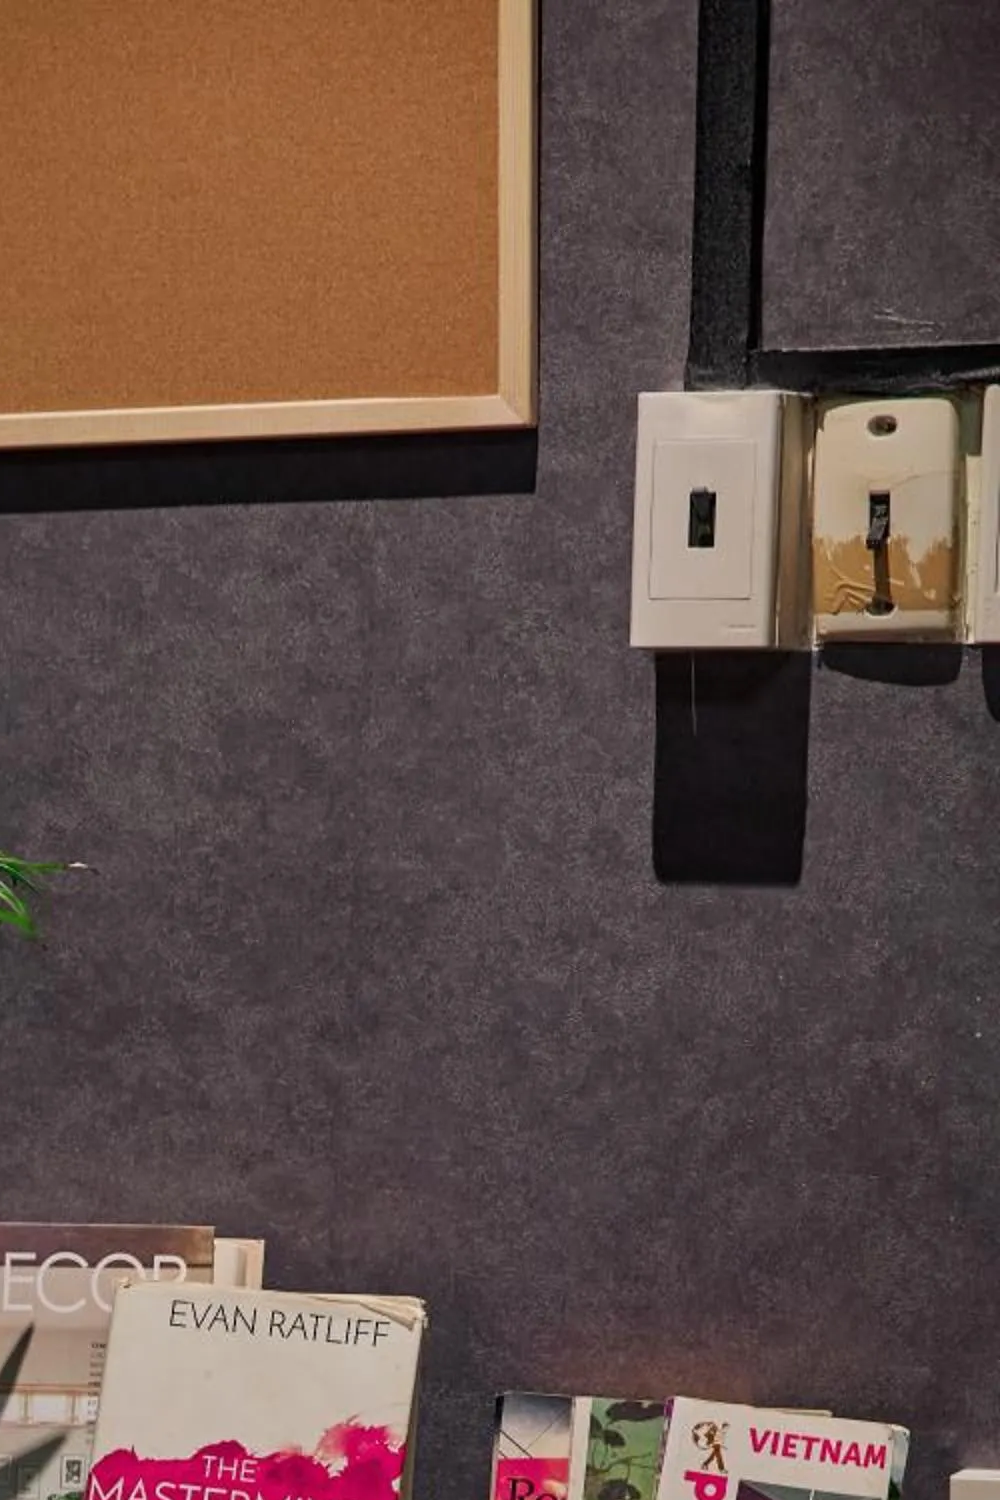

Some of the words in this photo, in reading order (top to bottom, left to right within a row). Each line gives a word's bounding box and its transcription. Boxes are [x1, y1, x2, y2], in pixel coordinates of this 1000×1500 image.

[169, 1299, 257, 1336] EVAN
[269, 1313, 392, 1347] RATLIFF
[202, 1454, 257, 1484] THE
[748, 1427, 888, 1470] VIETNAM
